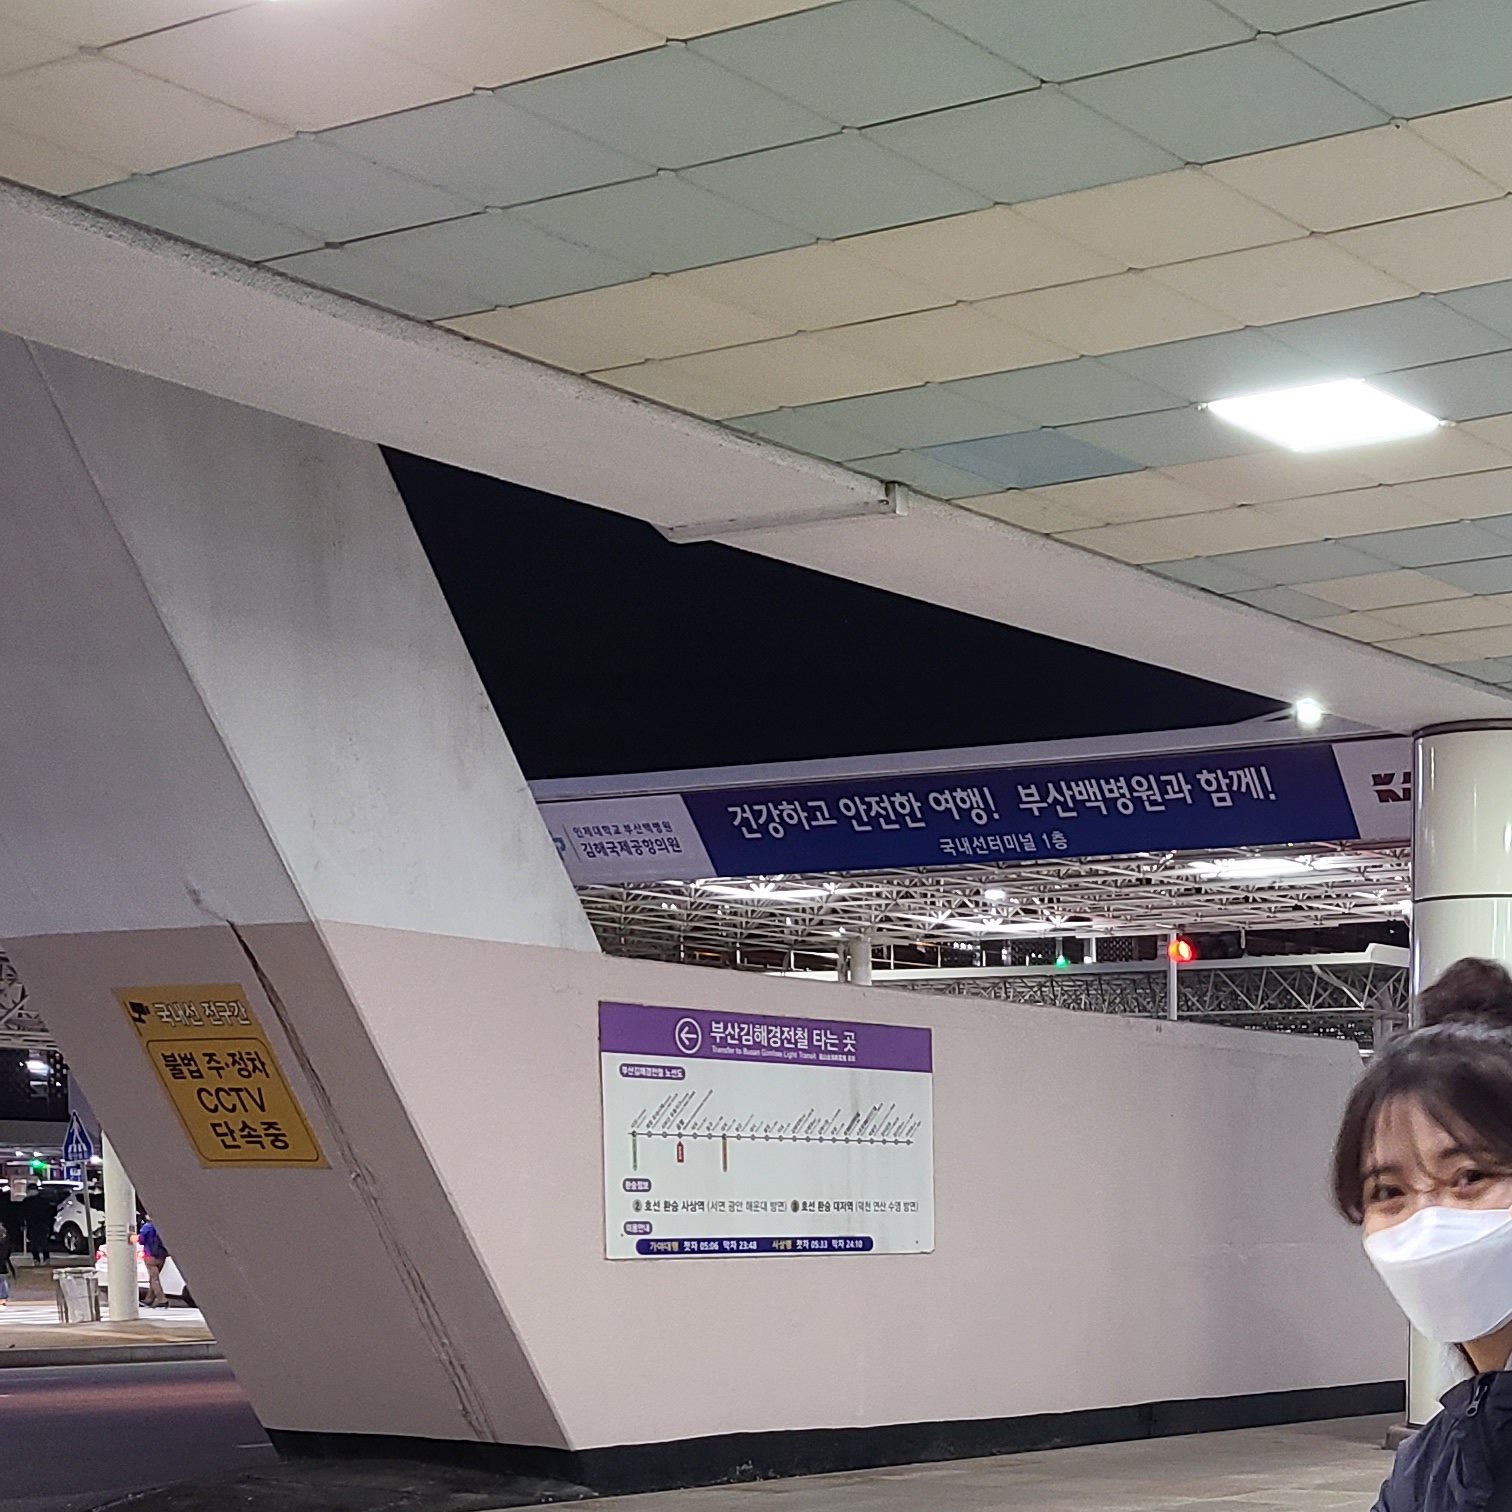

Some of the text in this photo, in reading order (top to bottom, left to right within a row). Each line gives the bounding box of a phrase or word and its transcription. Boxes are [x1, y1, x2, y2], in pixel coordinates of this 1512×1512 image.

[727, 766, 1278, 840] 건강하고 안전한 여행! 부산백병원과 함께!
[573, 821, 673, 838] 인제대학교 부산백병원
[580, 837, 682, 858] 김해국제공항의원
[939, 830, 1069, 857] 국내선터미널 1층
[153, 1000, 251, 1026] 국내선 전구간
[710, 1020, 857, 1053] 부산김해경전철 타는 곳
[161, 1051, 204, 1080] 불법
[196, 1087, 266, 1114] CCTV
[210, 1120, 289, 1150] 단속중
